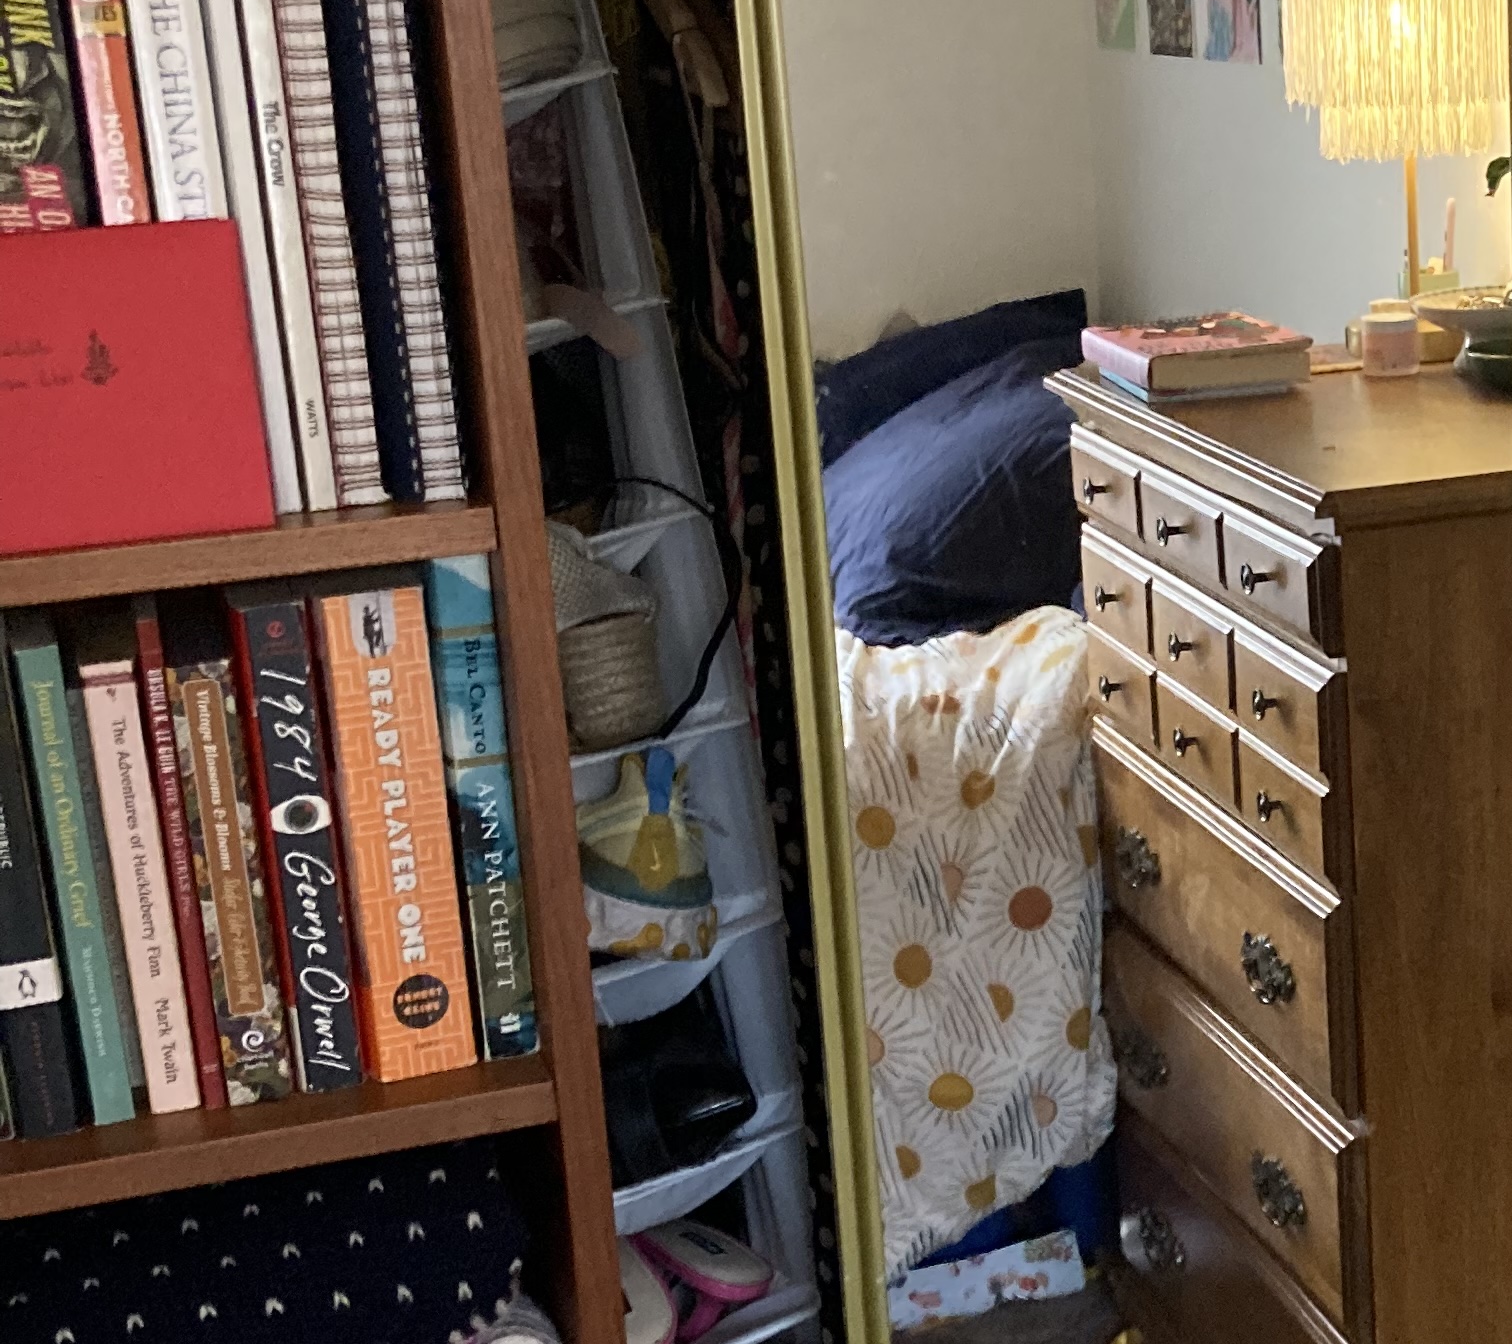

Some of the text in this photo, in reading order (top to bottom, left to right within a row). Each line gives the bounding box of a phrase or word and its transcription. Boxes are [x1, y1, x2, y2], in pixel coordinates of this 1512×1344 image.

[156, 43, 199, 163] CHINA
[262, 100, 281, 137] The
[25, 167, 64, 199] AN
[103, 113, 131, 190] NORTH
[305, 398, 319, 439] WATTS
[31, 680, 63, 746] Journal
[195, 689, 212, 743] Vintage
[260, 667, 318, 782] 1984
[46, 750, 67, 768] of
[51, 773, 65, 794] an
[203, 743, 223, 806] Blossoms
[55, 797, 79, 877] Ordinary
[214, 822, 232, 872] Blooms
[368, 666, 426, 964] READY PLAYER ONE
[111, 719, 162, 978] The Adventures of Huckleberry Finn
[68, 880, 95, 930] Grief
[476, 783, 517, 990] ANN PATCHETT
[284, 850, 352, 1072] George Orwell
[154, 996, 178, 1085] Mark Twain
